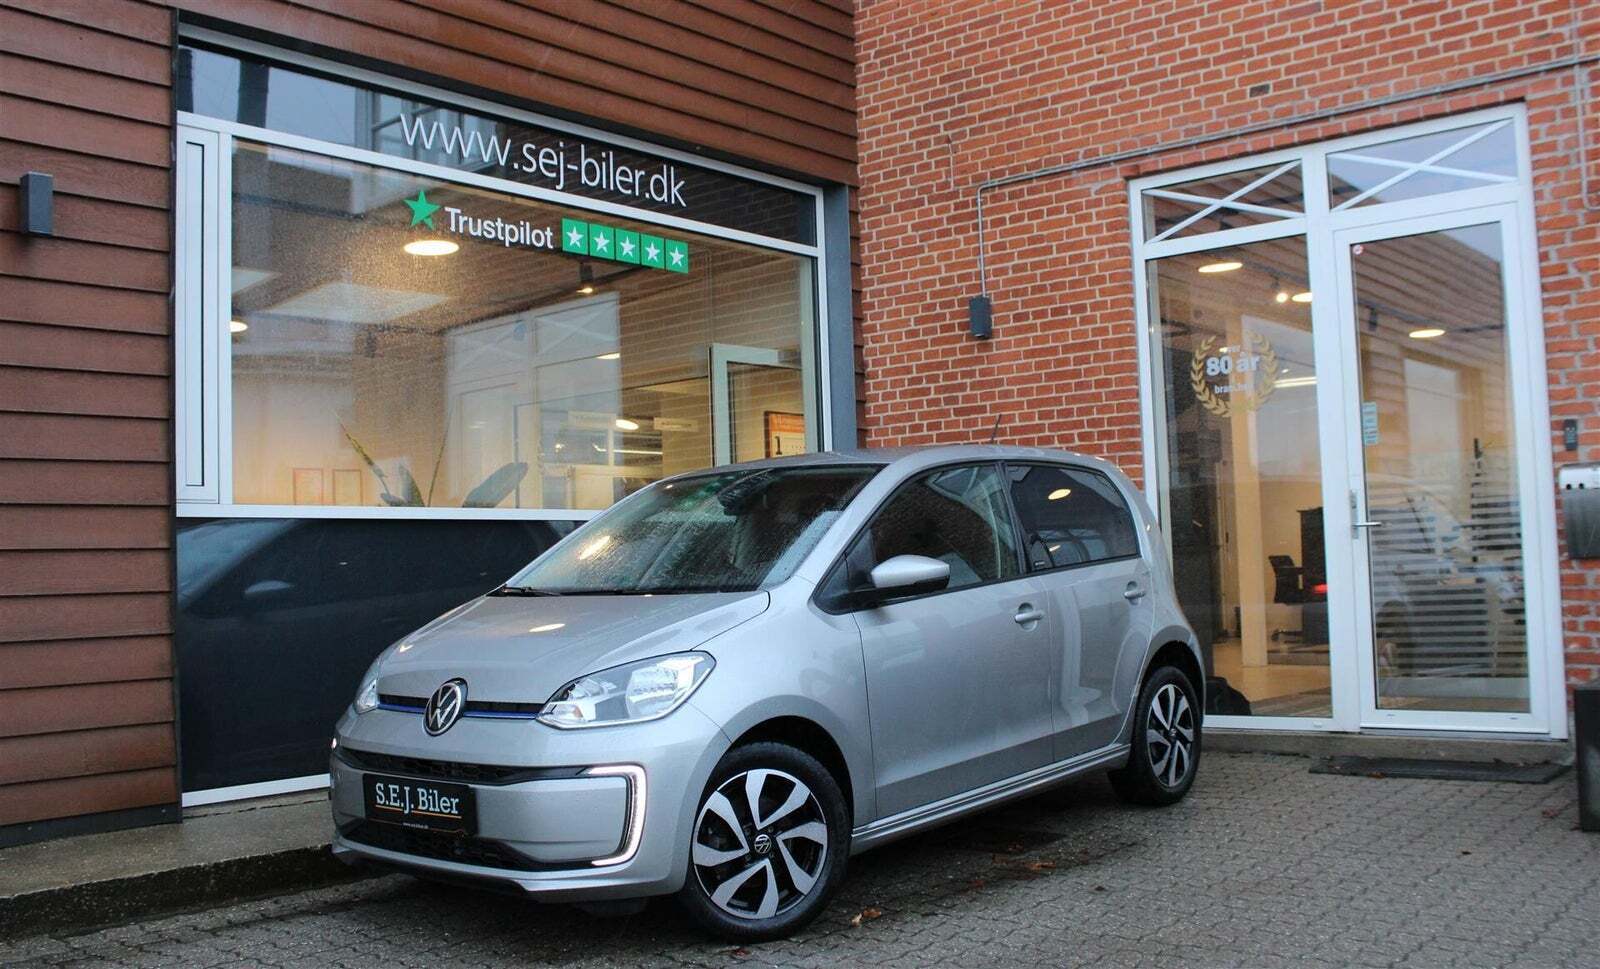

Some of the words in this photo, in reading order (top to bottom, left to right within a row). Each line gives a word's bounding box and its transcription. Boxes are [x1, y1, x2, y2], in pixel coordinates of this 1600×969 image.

[400, 113, 687, 208] www.sej-biler.dk
[445, 207, 554, 250] Trustpilot
[1206, 355, 1233, 376] 80
[375, 782, 414, 814] S.E.J.
[417, 787, 460, 814] Biler
